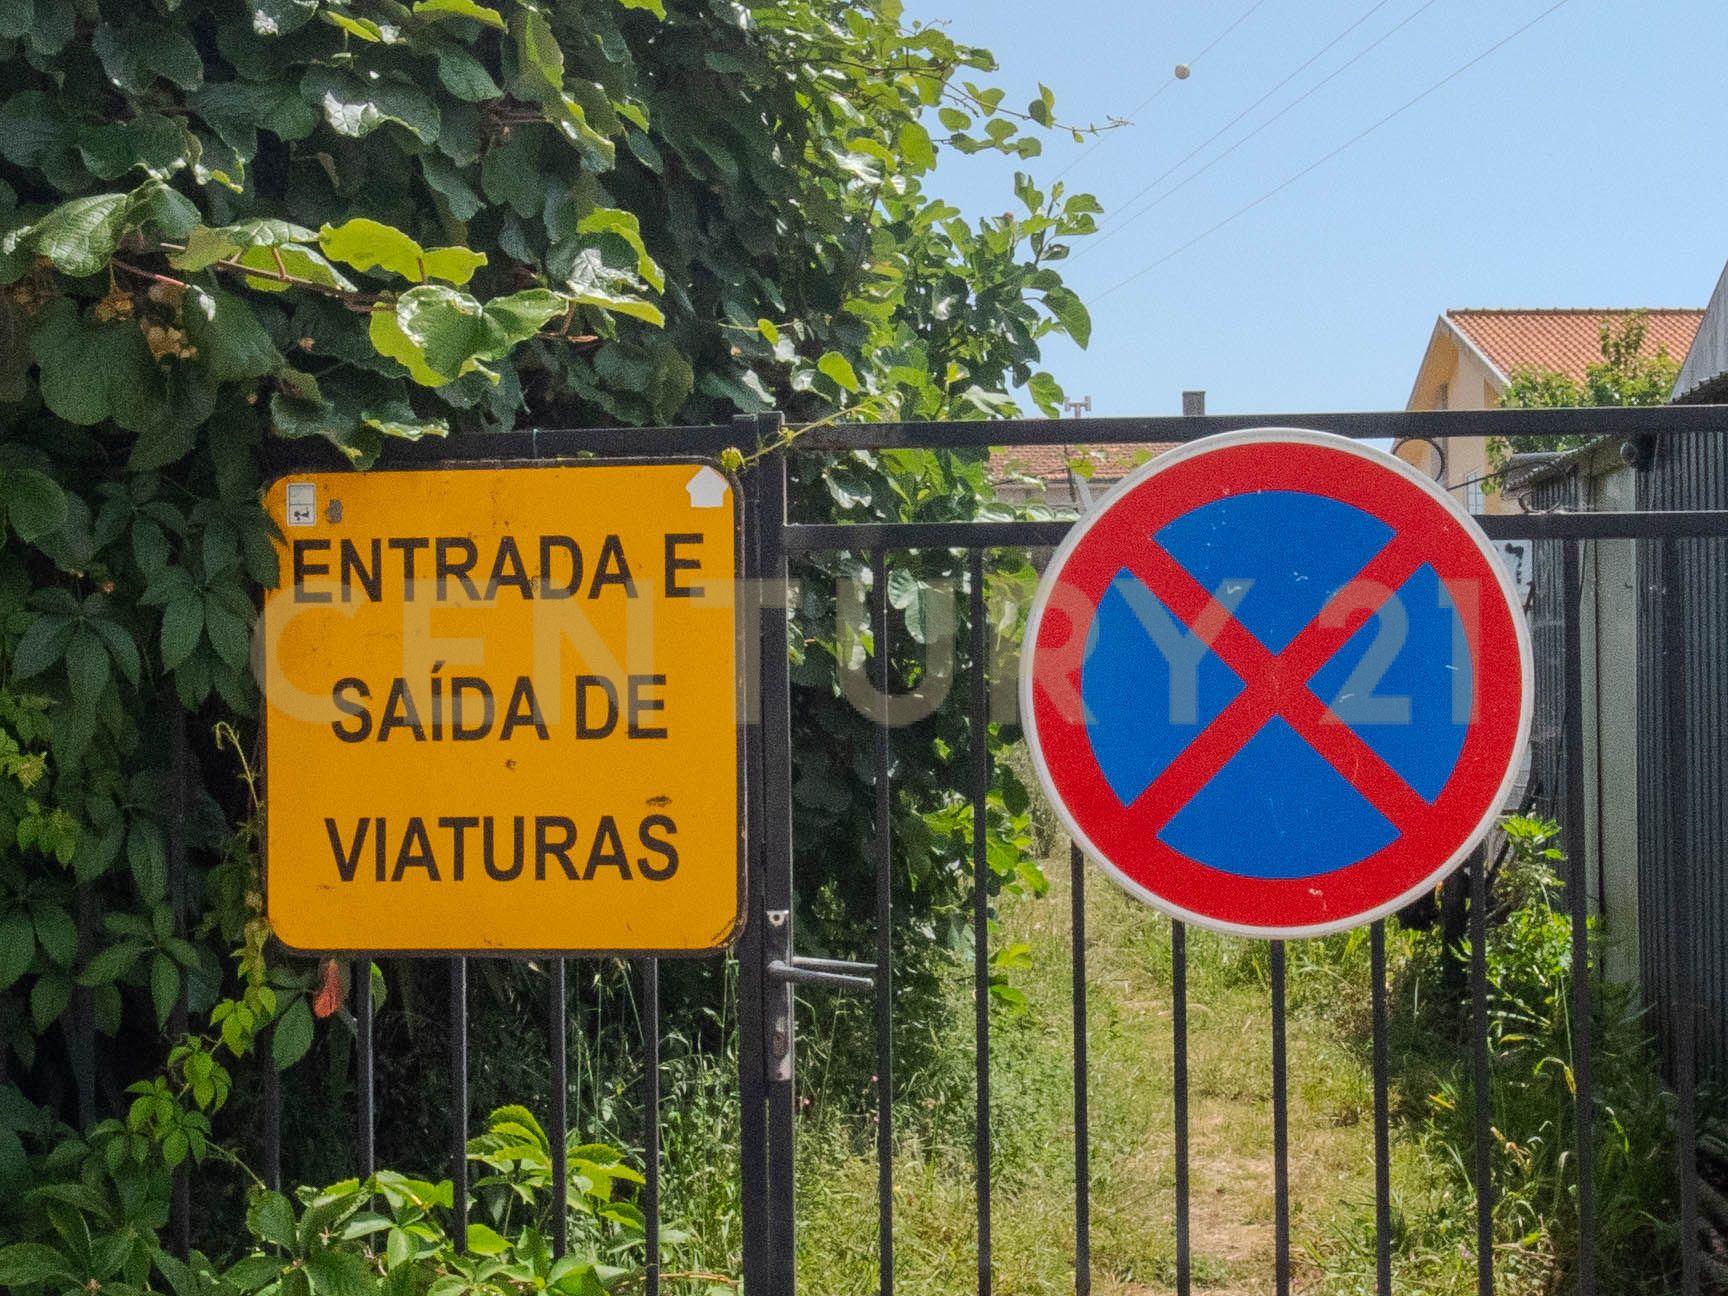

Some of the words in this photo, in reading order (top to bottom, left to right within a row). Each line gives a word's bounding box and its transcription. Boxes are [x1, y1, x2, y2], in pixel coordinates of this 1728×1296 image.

[292, 533, 639, 604] ENTRADA
[664, 532, 706, 599] E
[330, 660, 551, 744] SAÍDA
[574, 674, 669, 740] DE
[324, 814, 680, 883] VIATURAS
